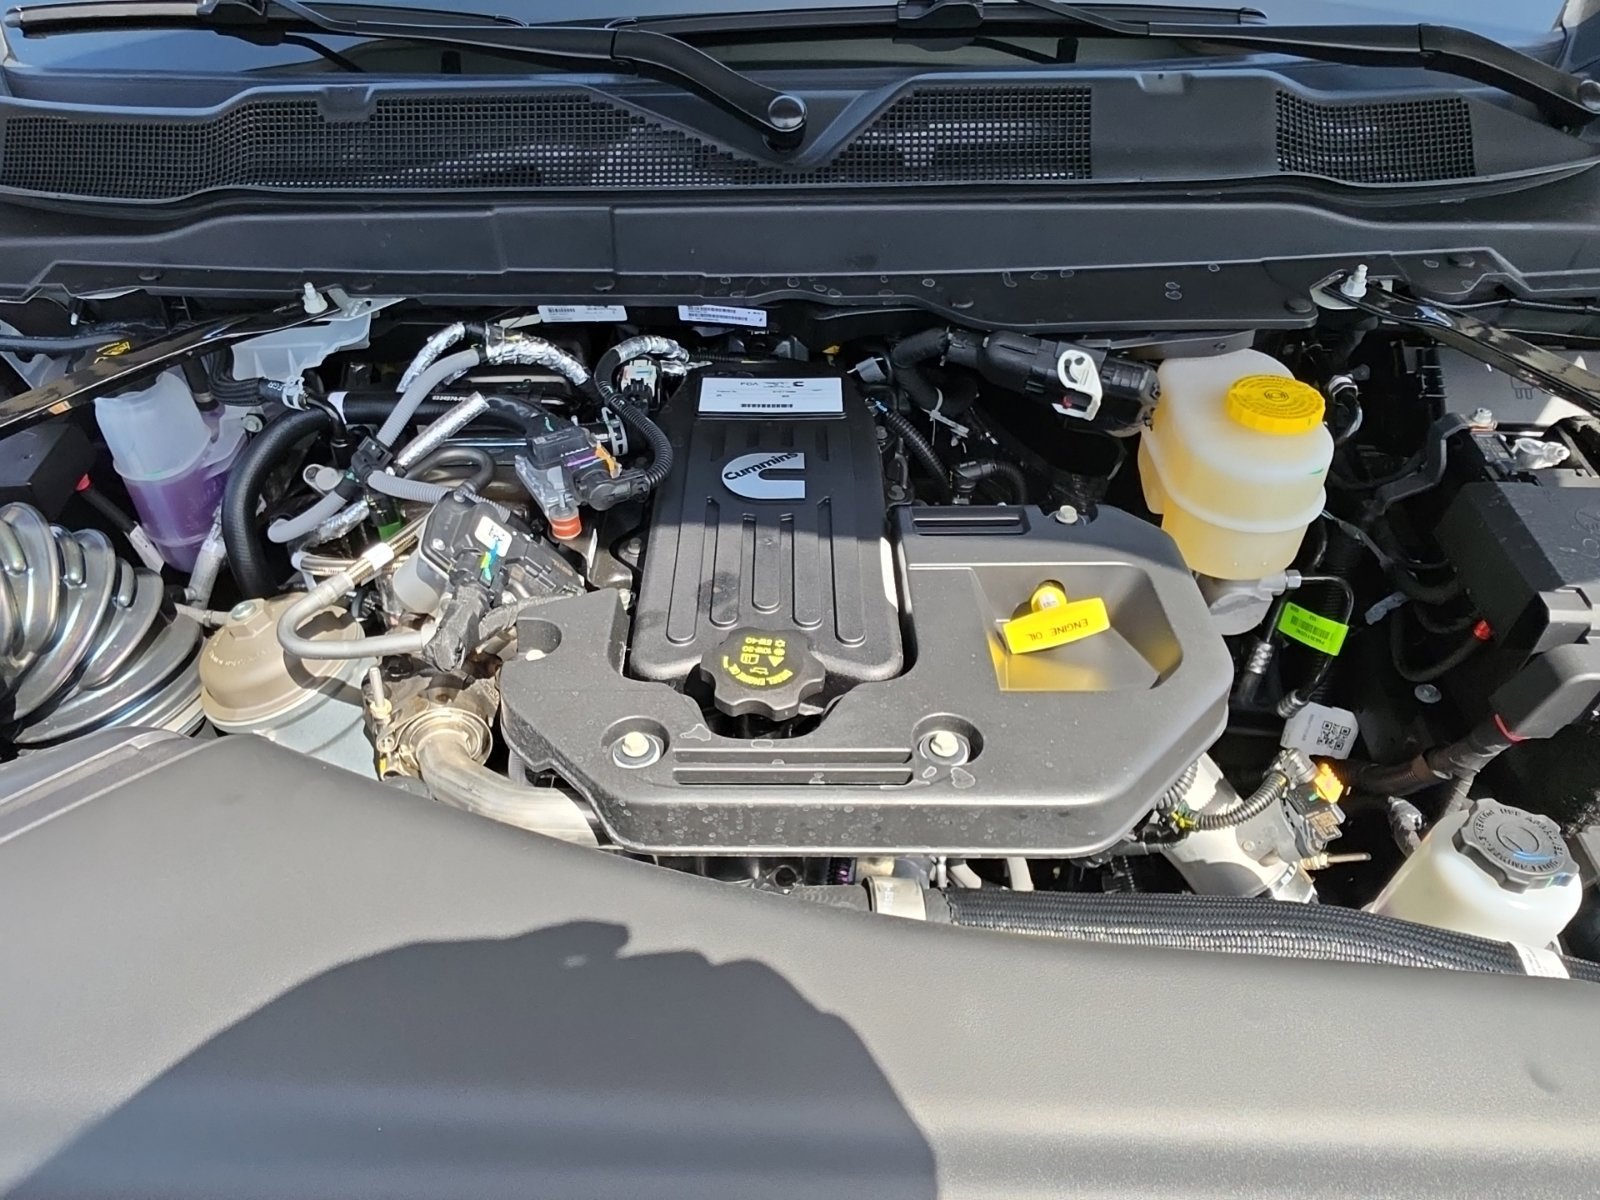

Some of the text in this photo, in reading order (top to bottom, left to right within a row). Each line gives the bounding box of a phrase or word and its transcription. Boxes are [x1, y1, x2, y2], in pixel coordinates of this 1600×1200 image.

[723, 453, 799, 480] Cummins
[1025, 619, 1088, 641] ENGINE OIL
